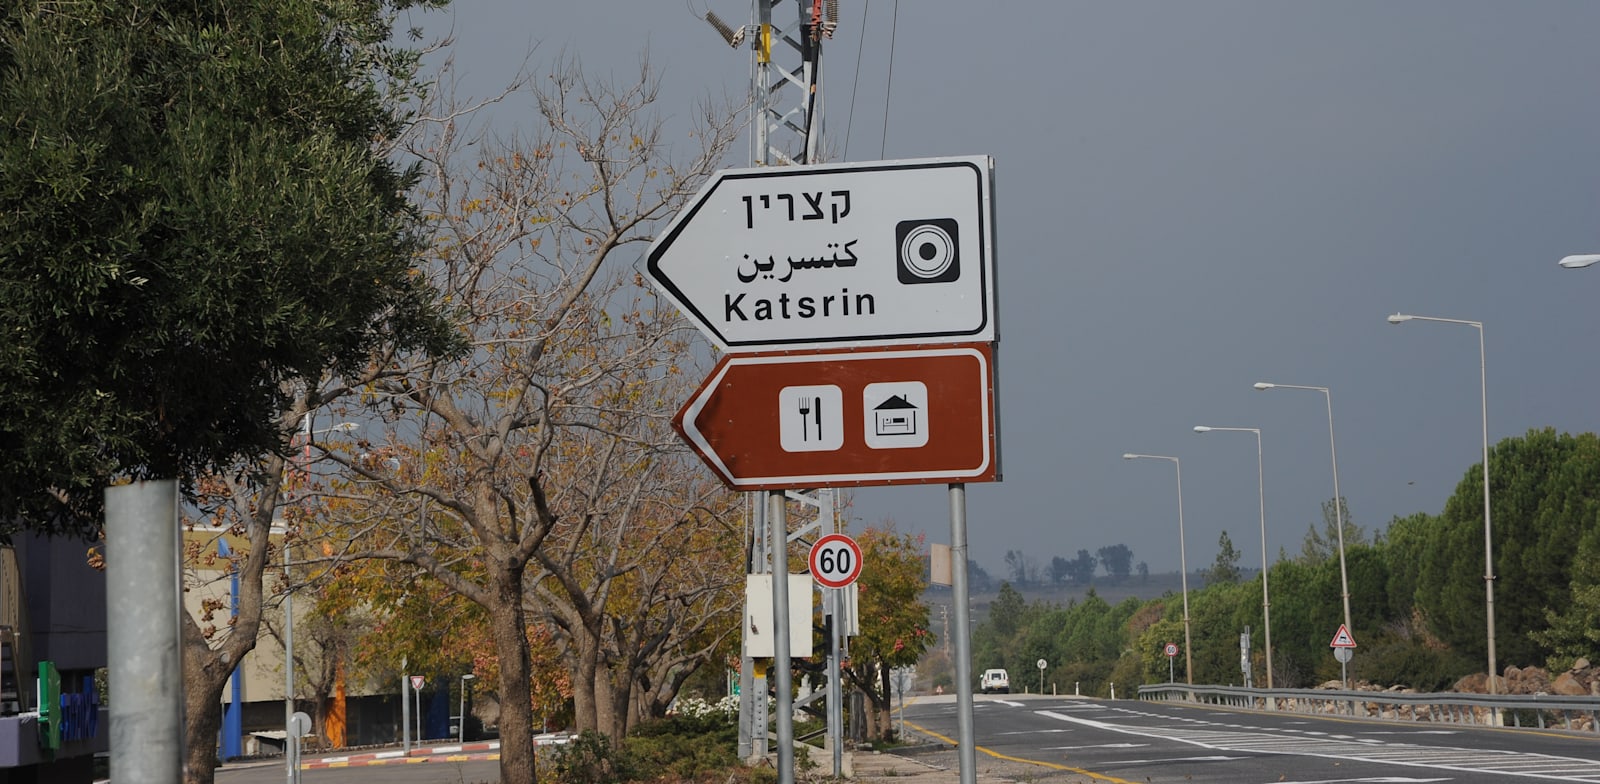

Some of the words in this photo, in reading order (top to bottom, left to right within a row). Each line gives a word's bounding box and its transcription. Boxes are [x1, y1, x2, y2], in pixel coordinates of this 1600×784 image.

[741, 189, 851, 229] קצרין
[737, 239, 858, 283] كتسرين
[724, 287, 876, 322] Katsrin
[820, 547, 851, 574] 60
